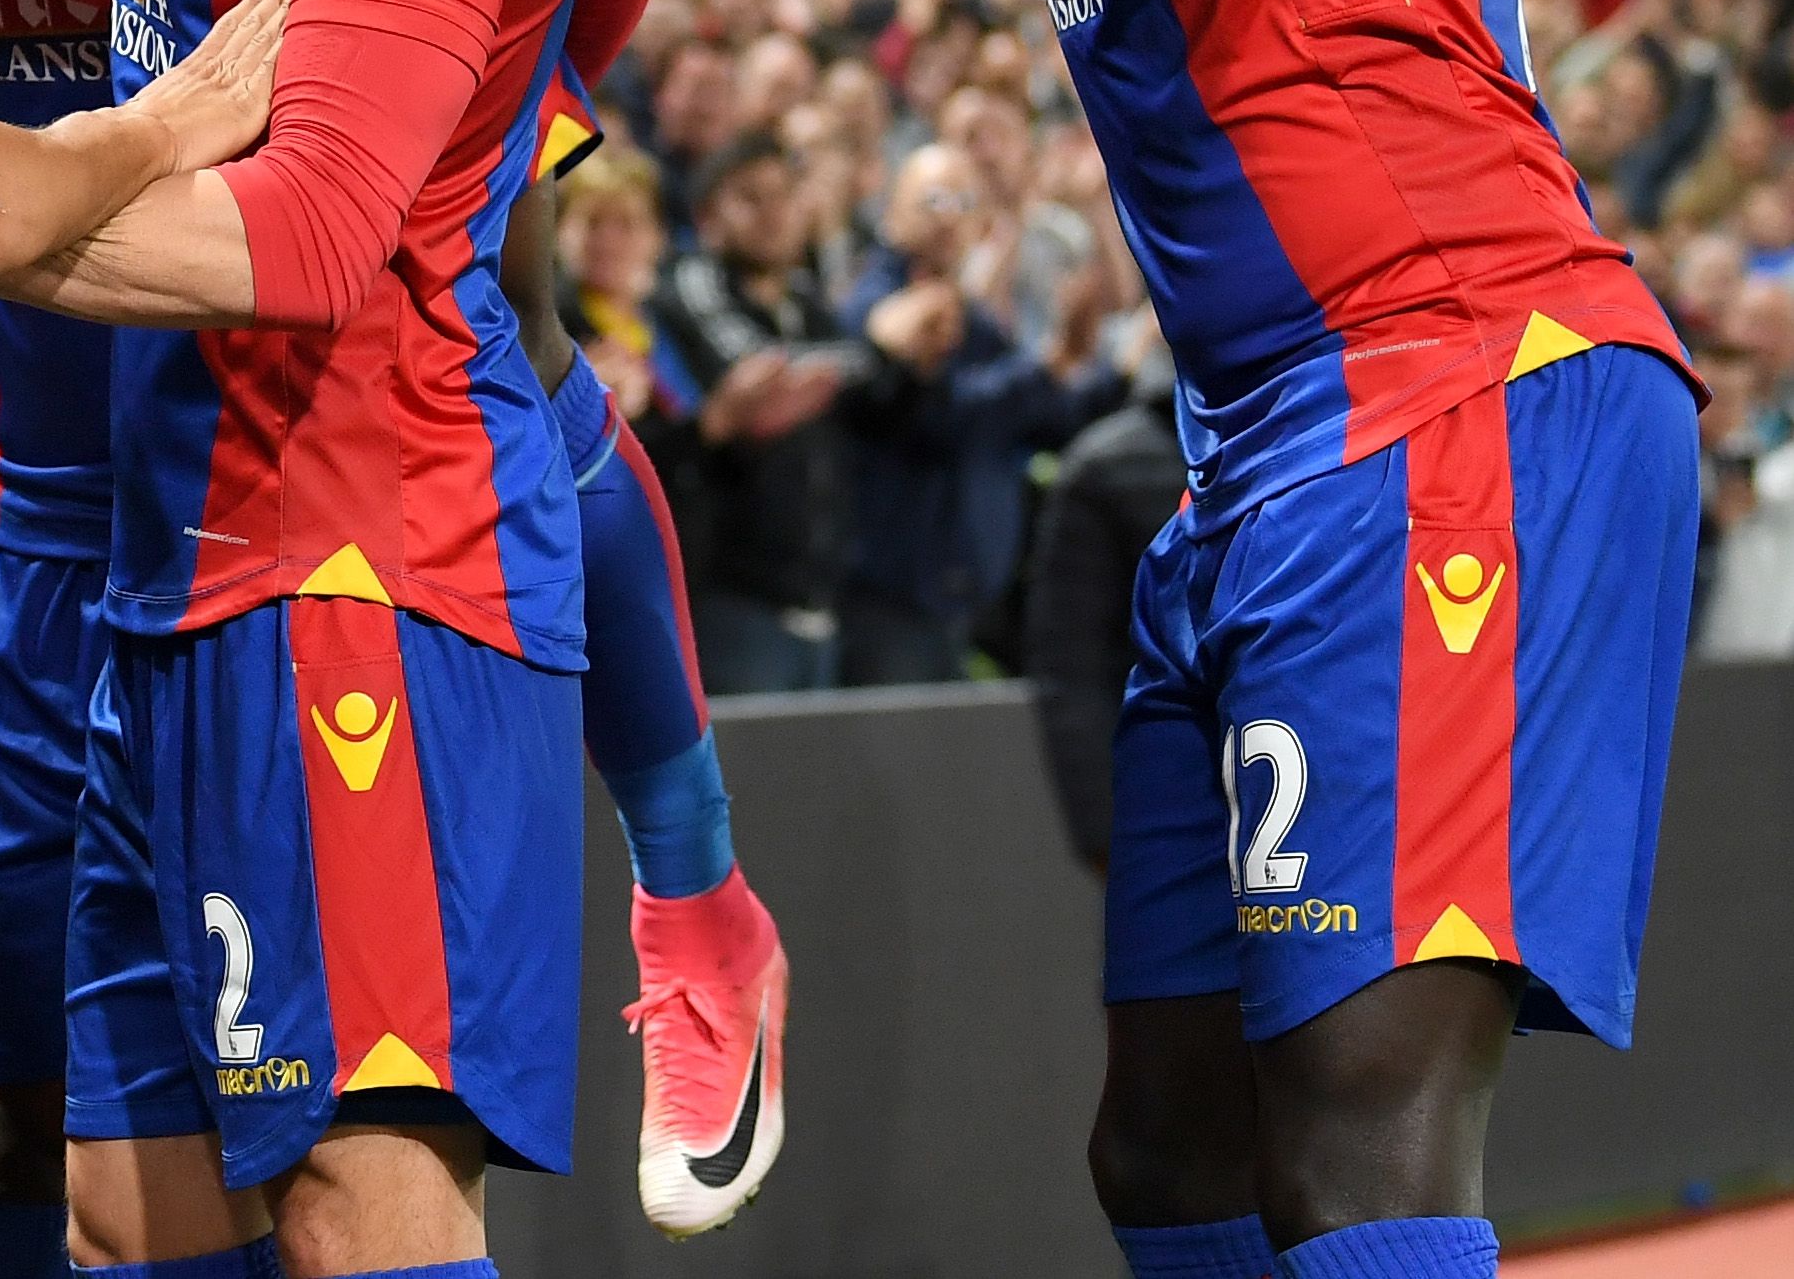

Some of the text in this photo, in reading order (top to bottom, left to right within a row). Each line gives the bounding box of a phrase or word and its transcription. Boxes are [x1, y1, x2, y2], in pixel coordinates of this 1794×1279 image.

[1222, 719, 1309, 898] 12
[1237, 898, 1357, 933] macron
[202, 892, 264, 1064] 2
[215, 1056, 311, 1096] macron
